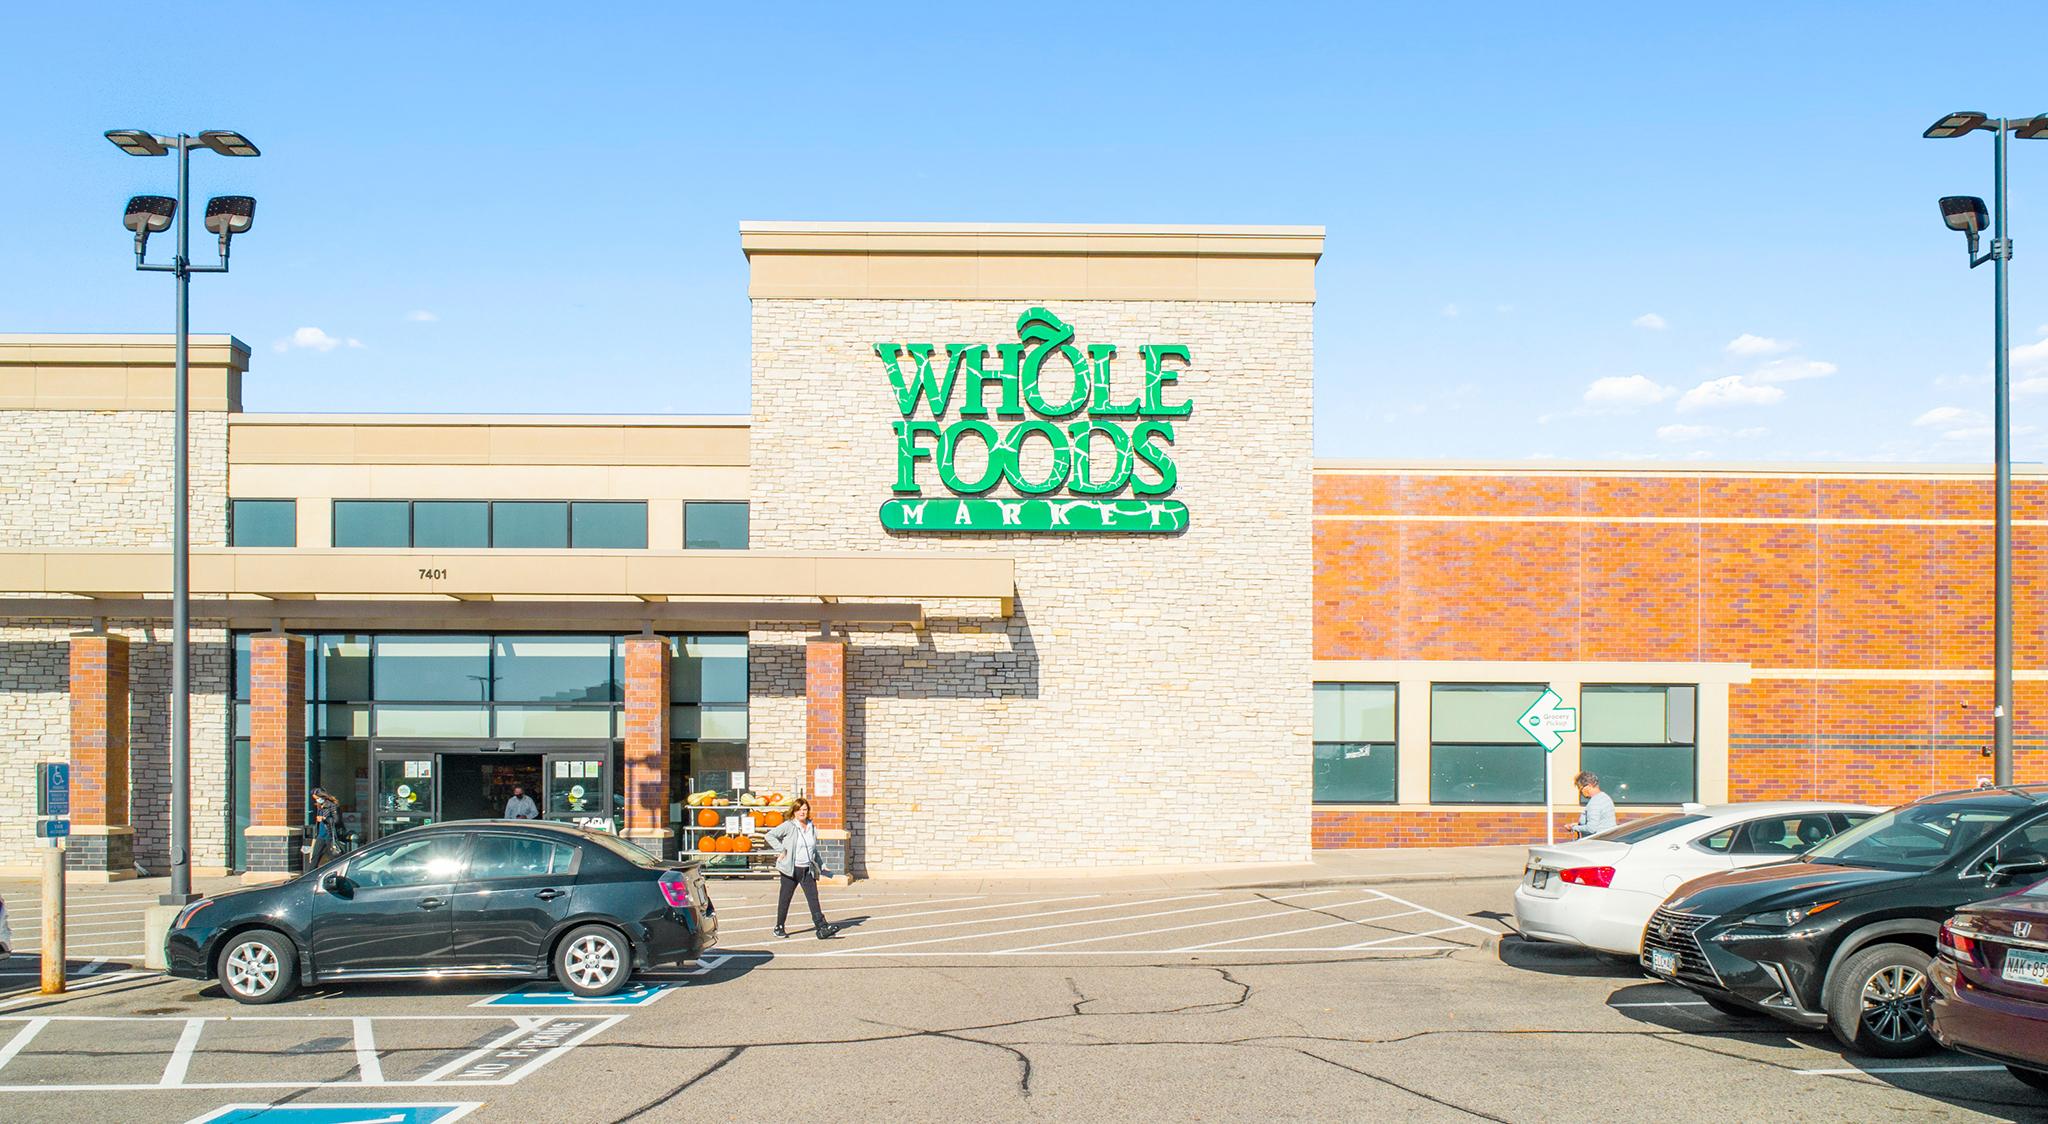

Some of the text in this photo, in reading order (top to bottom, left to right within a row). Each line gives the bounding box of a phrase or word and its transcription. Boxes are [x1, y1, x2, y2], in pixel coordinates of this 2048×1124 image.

[872, 307, 1194, 416] WHOLE
[891, 420, 1178, 494] FOODS
[902, 500, 1167, 525] MARKET
[418, 568, 447, 580] 7401
[457, 1063, 510, 1077] NO
